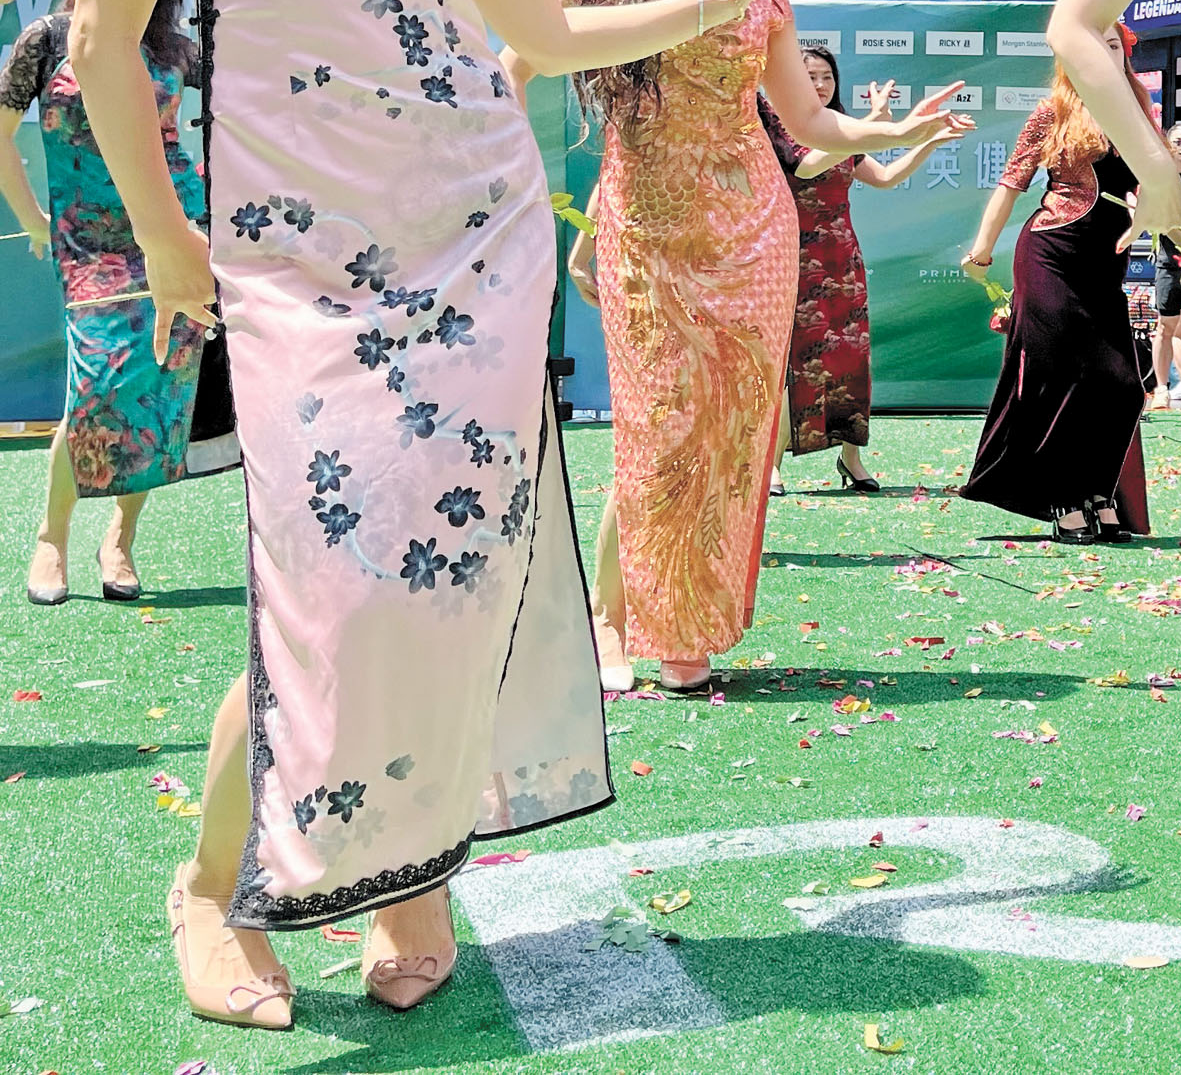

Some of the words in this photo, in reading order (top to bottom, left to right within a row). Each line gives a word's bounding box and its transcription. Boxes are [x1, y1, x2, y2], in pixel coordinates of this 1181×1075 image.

[862, 39, 884, 47] ROSIE
[886, 39, 907, 47] SHEN
[939, 39, 961, 47] RICKY
